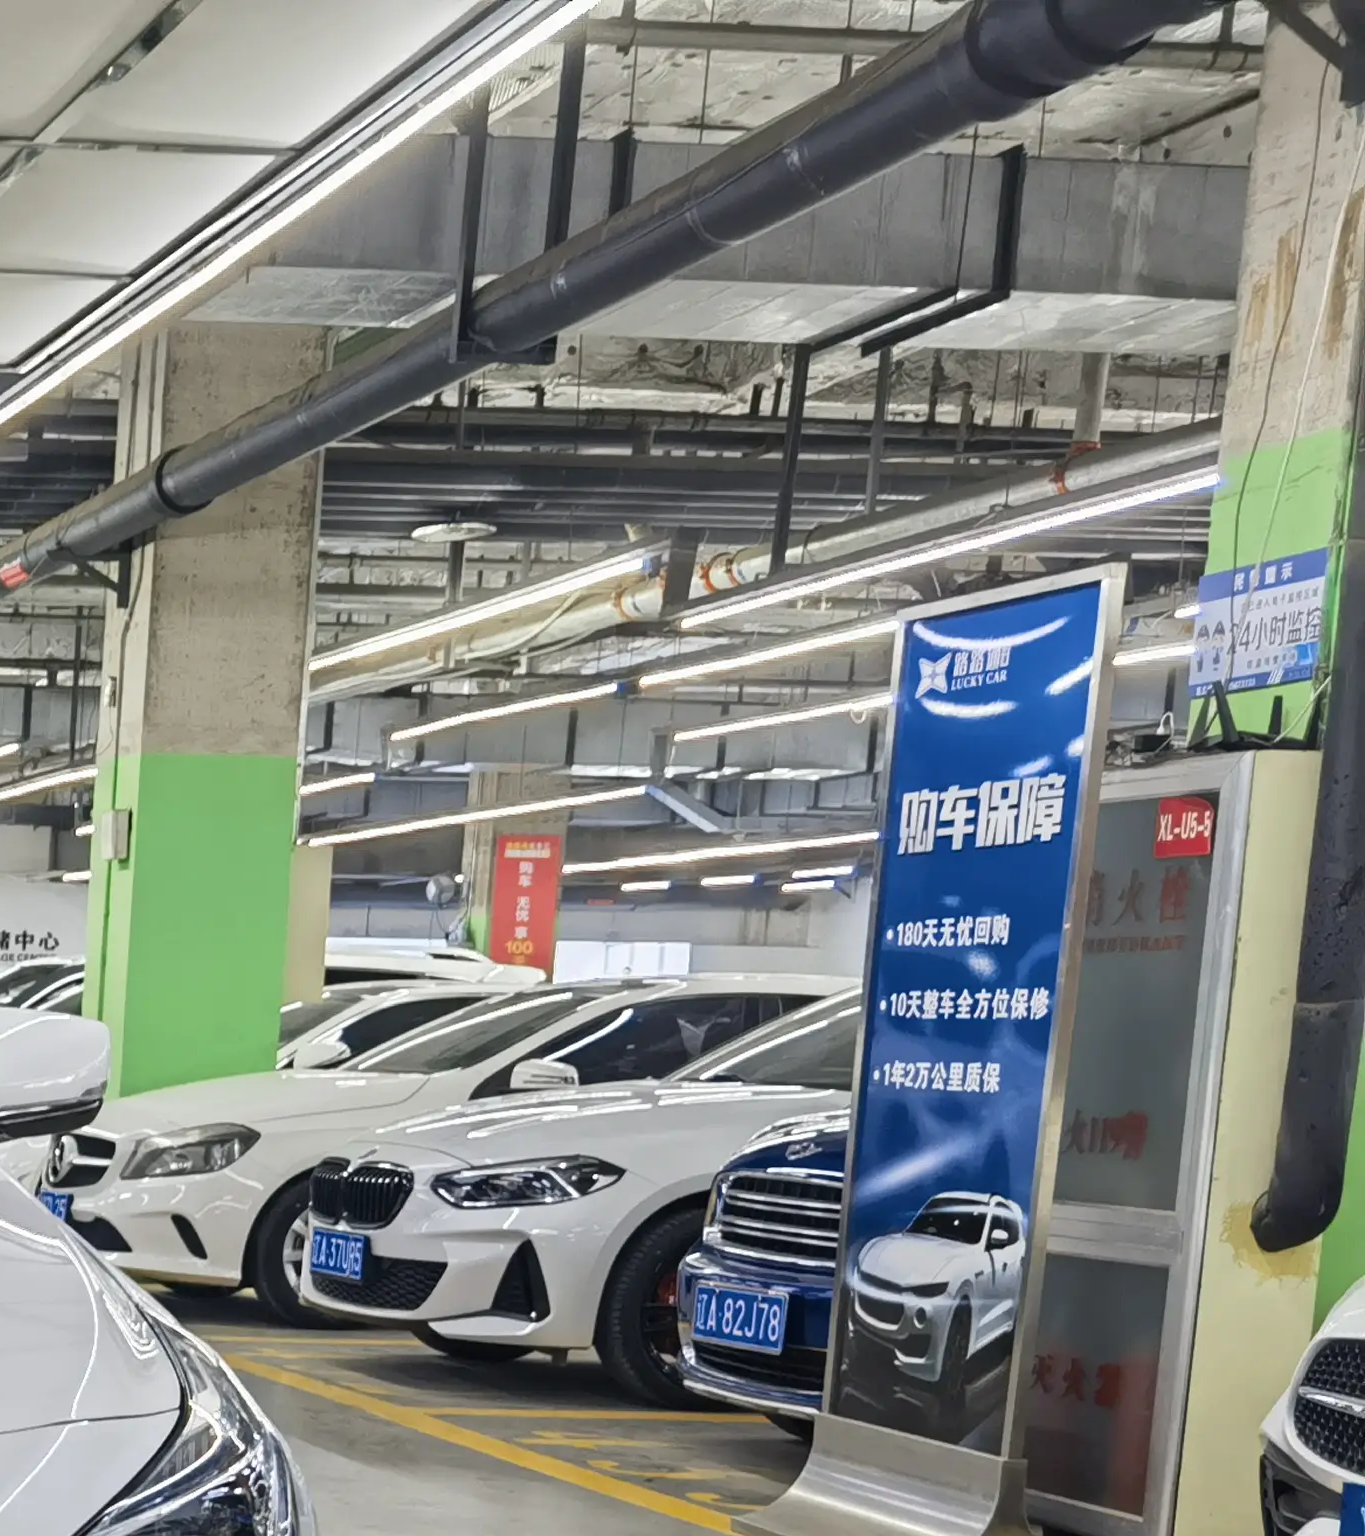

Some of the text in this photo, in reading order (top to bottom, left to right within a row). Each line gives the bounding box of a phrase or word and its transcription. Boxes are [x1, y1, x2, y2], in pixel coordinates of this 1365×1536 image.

[951, 669, 1008, 691] LUCKY CAR
[897, 773, 1067, 855] 购车保障
[1157, 810, 1211, 842] XL-U5-5
[896, 914, 1011, 948] 180天无忧回购
[889, 987, 1050, 1021] 10天整车全方位保修
[883, 1059, 1001, 1093] 1年2万公里质保
